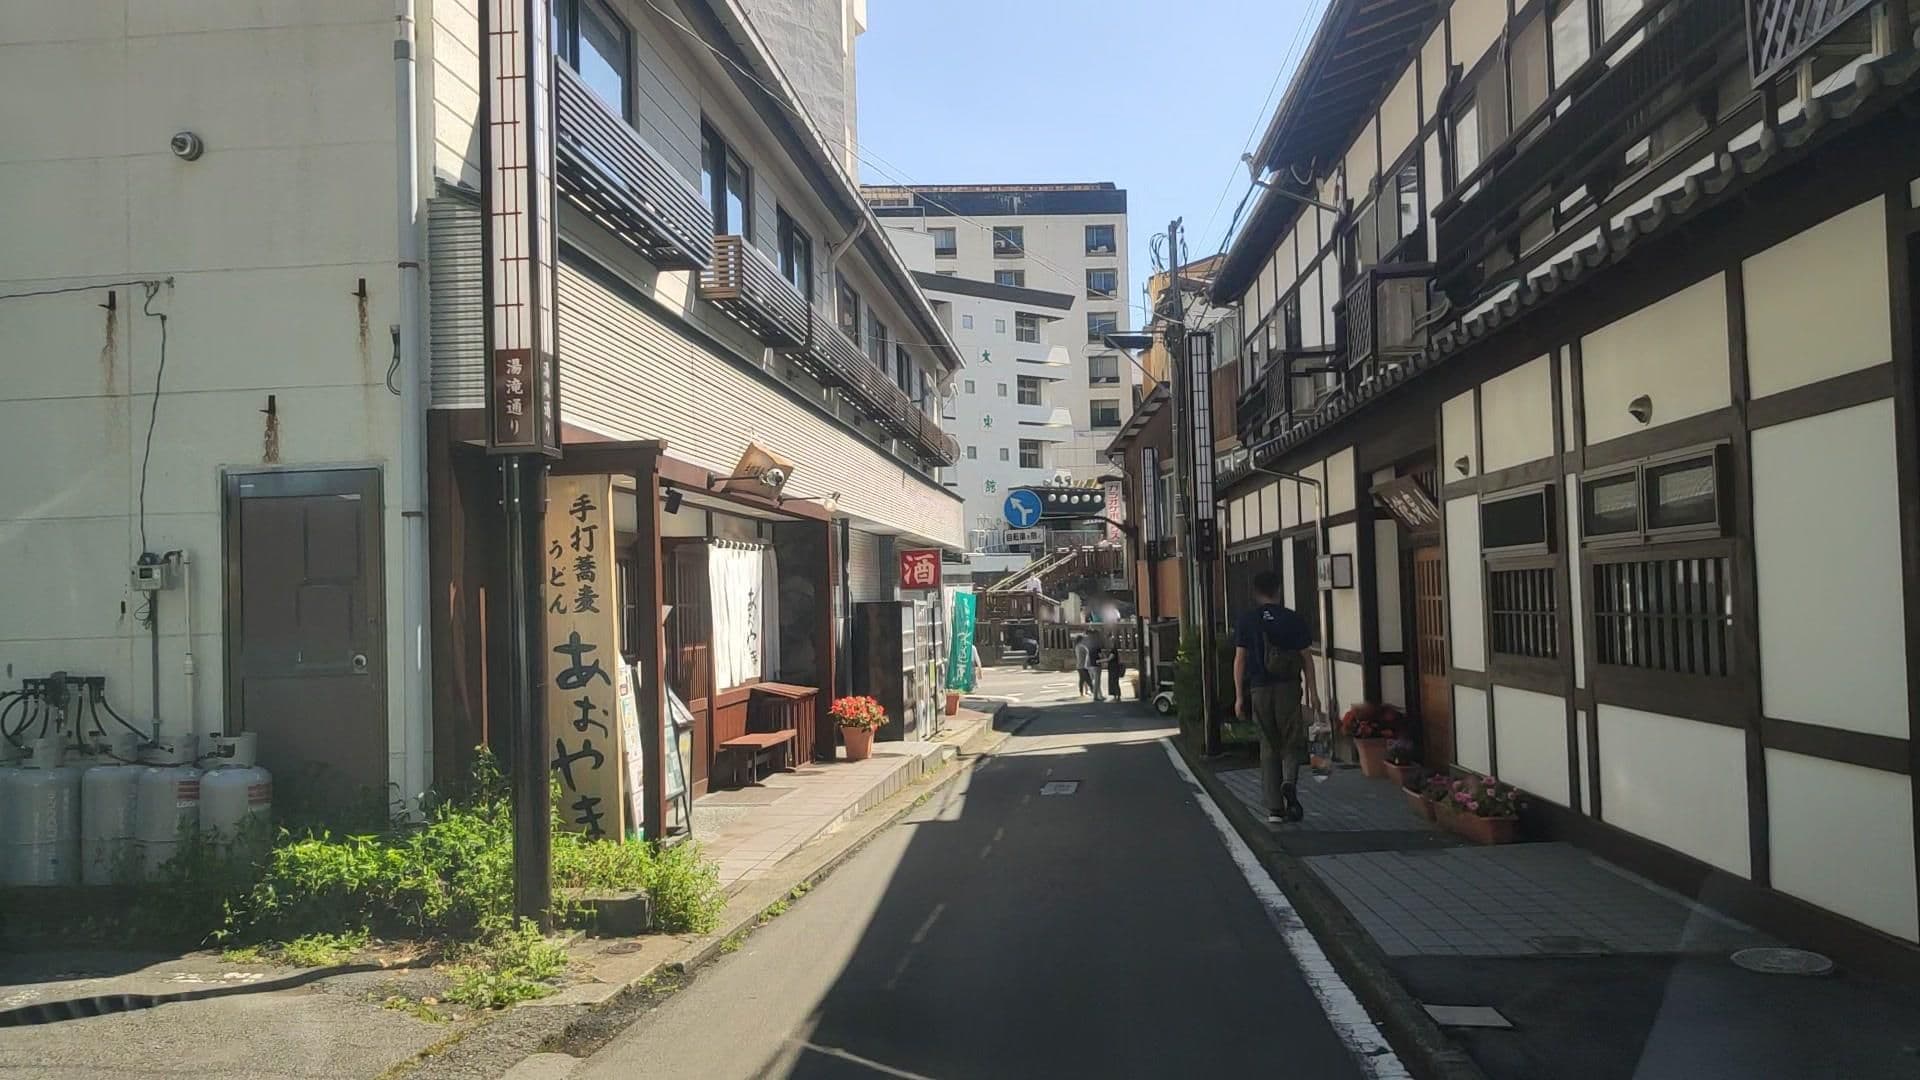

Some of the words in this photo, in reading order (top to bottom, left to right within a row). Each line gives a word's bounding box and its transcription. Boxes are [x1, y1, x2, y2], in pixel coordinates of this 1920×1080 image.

[505, 358, 523, 435] 湯滝通り
[548, 540, 567, 614] うどん
[569, 494, 600, 614] 手打蕎麦
[903, 553, 935, 585] 酒
[551, 630, 611, 839] あおやま
